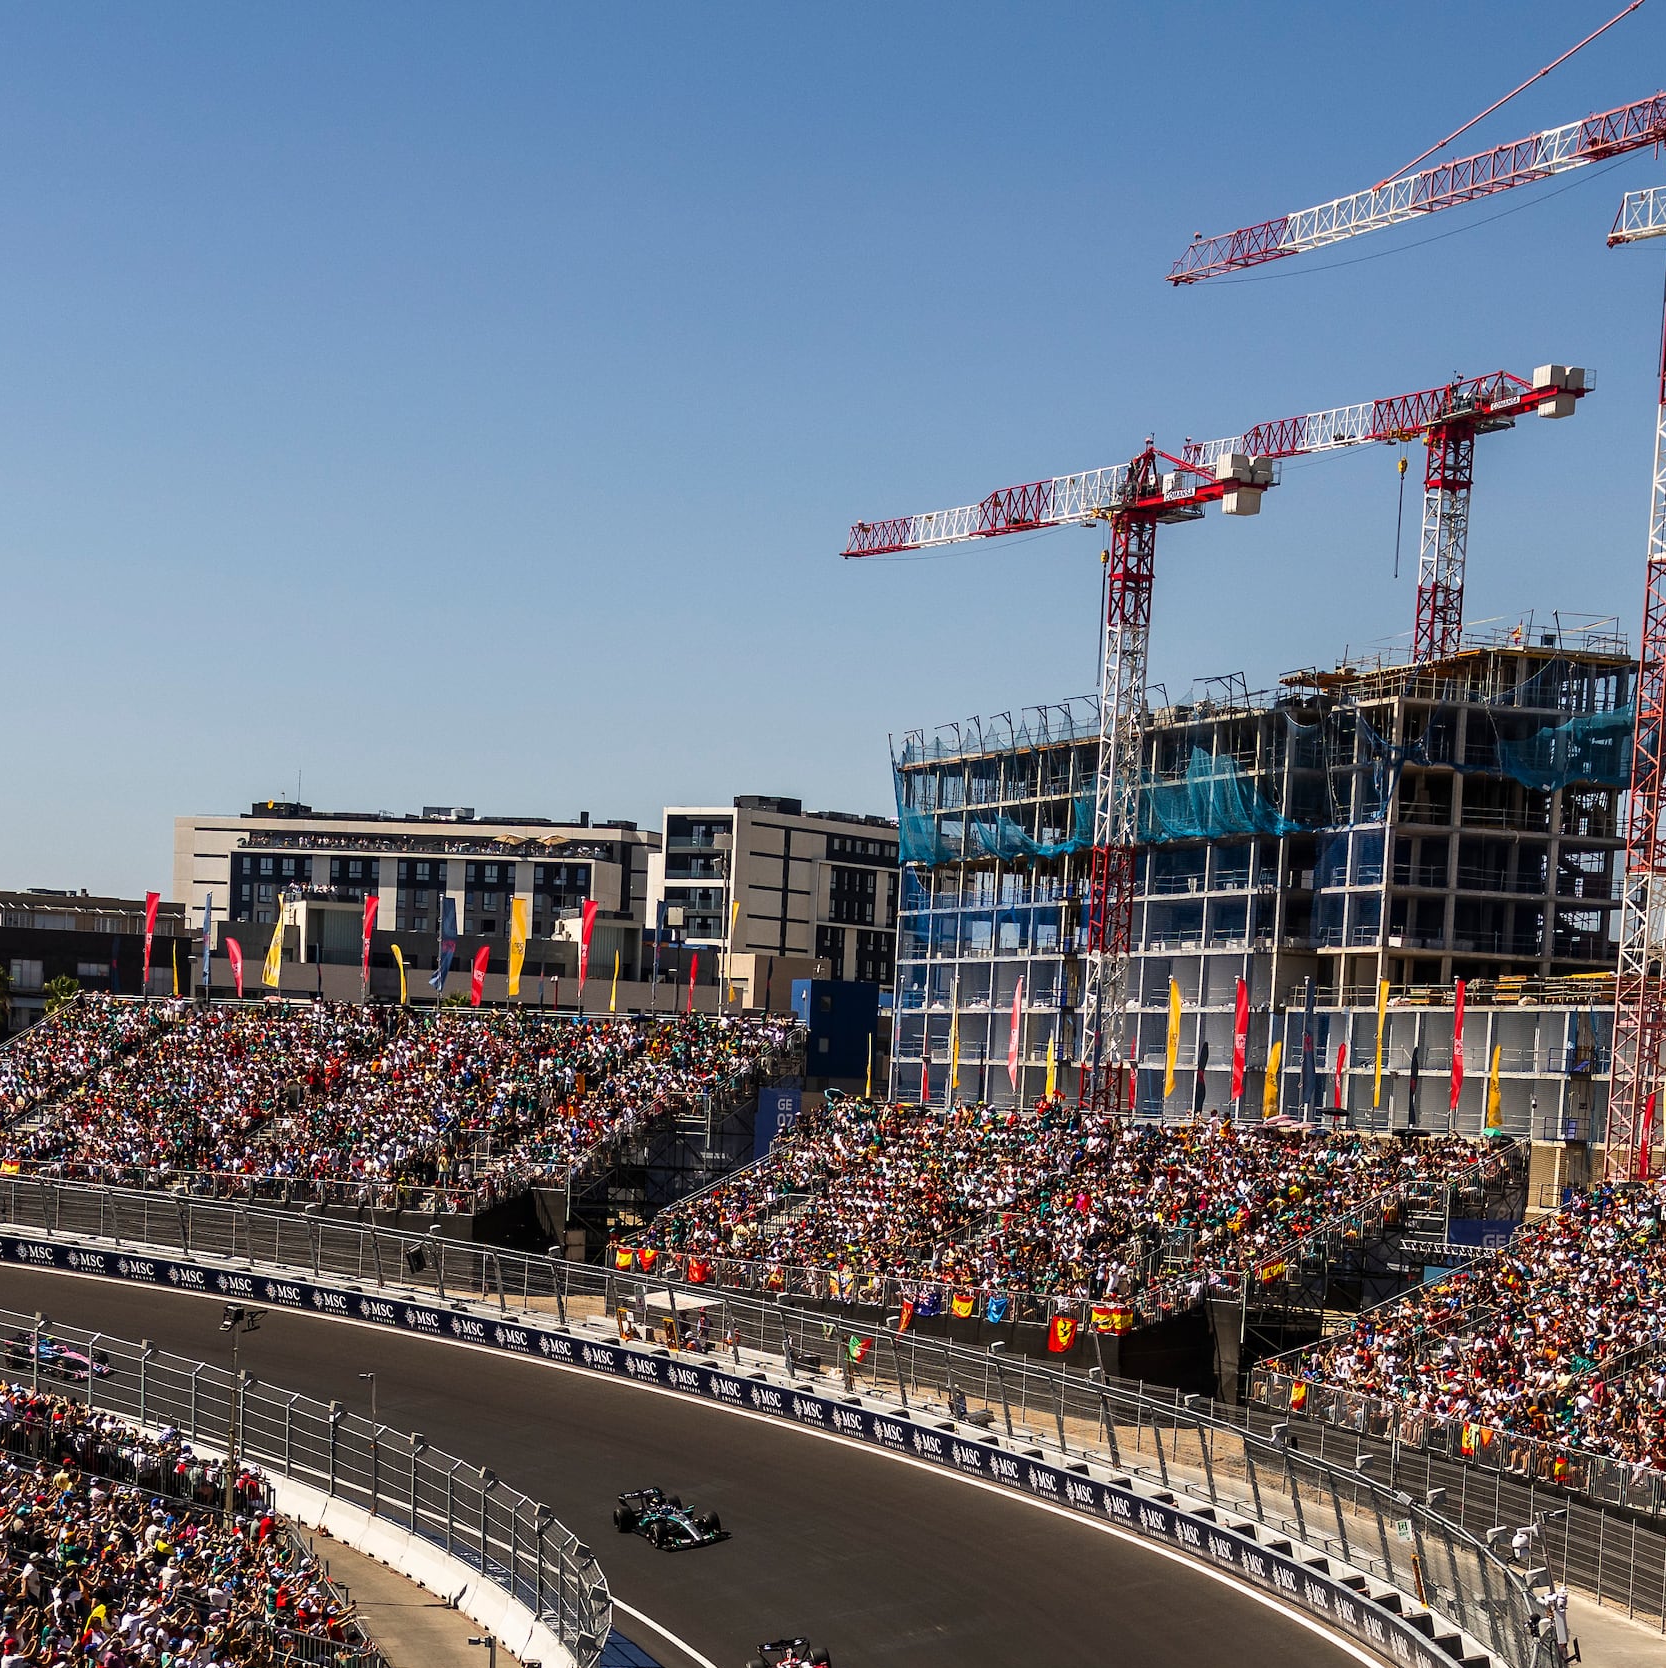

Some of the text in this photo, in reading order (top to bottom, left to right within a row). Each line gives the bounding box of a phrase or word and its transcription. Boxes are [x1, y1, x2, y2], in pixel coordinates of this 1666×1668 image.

[1491, 396, 1520, 410] COMANSA
[1165, 488, 1195, 501] COMANSA
[777, 1098, 793, 1111] GE
[777, 1113, 794, 1129] 07
[1483, 1234, 1507, 1248] GE
[29, 1245, 53, 1260] MSC
[80, 1253, 104, 1268] MSC
[130, 1261, 154, 1275] MSC
[180, 1269, 204, 1283] MSC
[228, 1276, 252, 1291] MSC
[277, 1285, 300, 1300] MSC
[324, 1293, 346, 1308] MSC
[371, 1302, 394, 1318] MSC
[416, 1311, 438, 1326] MSC
[462, 1320, 484, 1336] MSC
[505, 1329, 527, 1345] MSC
[550, 1338, 571, 1355] MSC
[592, 1348, 613, 1365] MSC
[635, 1358, 657, 1376] MSC
[677, 1368, 698, 1386] MSC
[719, 1379, 741, 1397] MSC
[759, 1389, 781, 1408] MSC
[800, 1400, 822, 1419] MSC
[841, 1411, 862, 1430] MSC
[882, 1422, 903, 1442] MSC
[922, 1434, 942, 1454] MSC
[960, 1446, 981, 1466] MSC
[999, 1458, 1018, 1478] MSC
[1037, 1470, 1057, 1491] MSC
[1074, 1483, 1093, 1504] MSC
[1111, 1495, 1131, 1517] MSC
[1147, 1509, 1166, 1531] MSC
[1182, 1522, 1200, 1546] MSC
[1215, 1537, 1233, 1561] MSC
[1248, 1552, 1265, 1577] MSC
